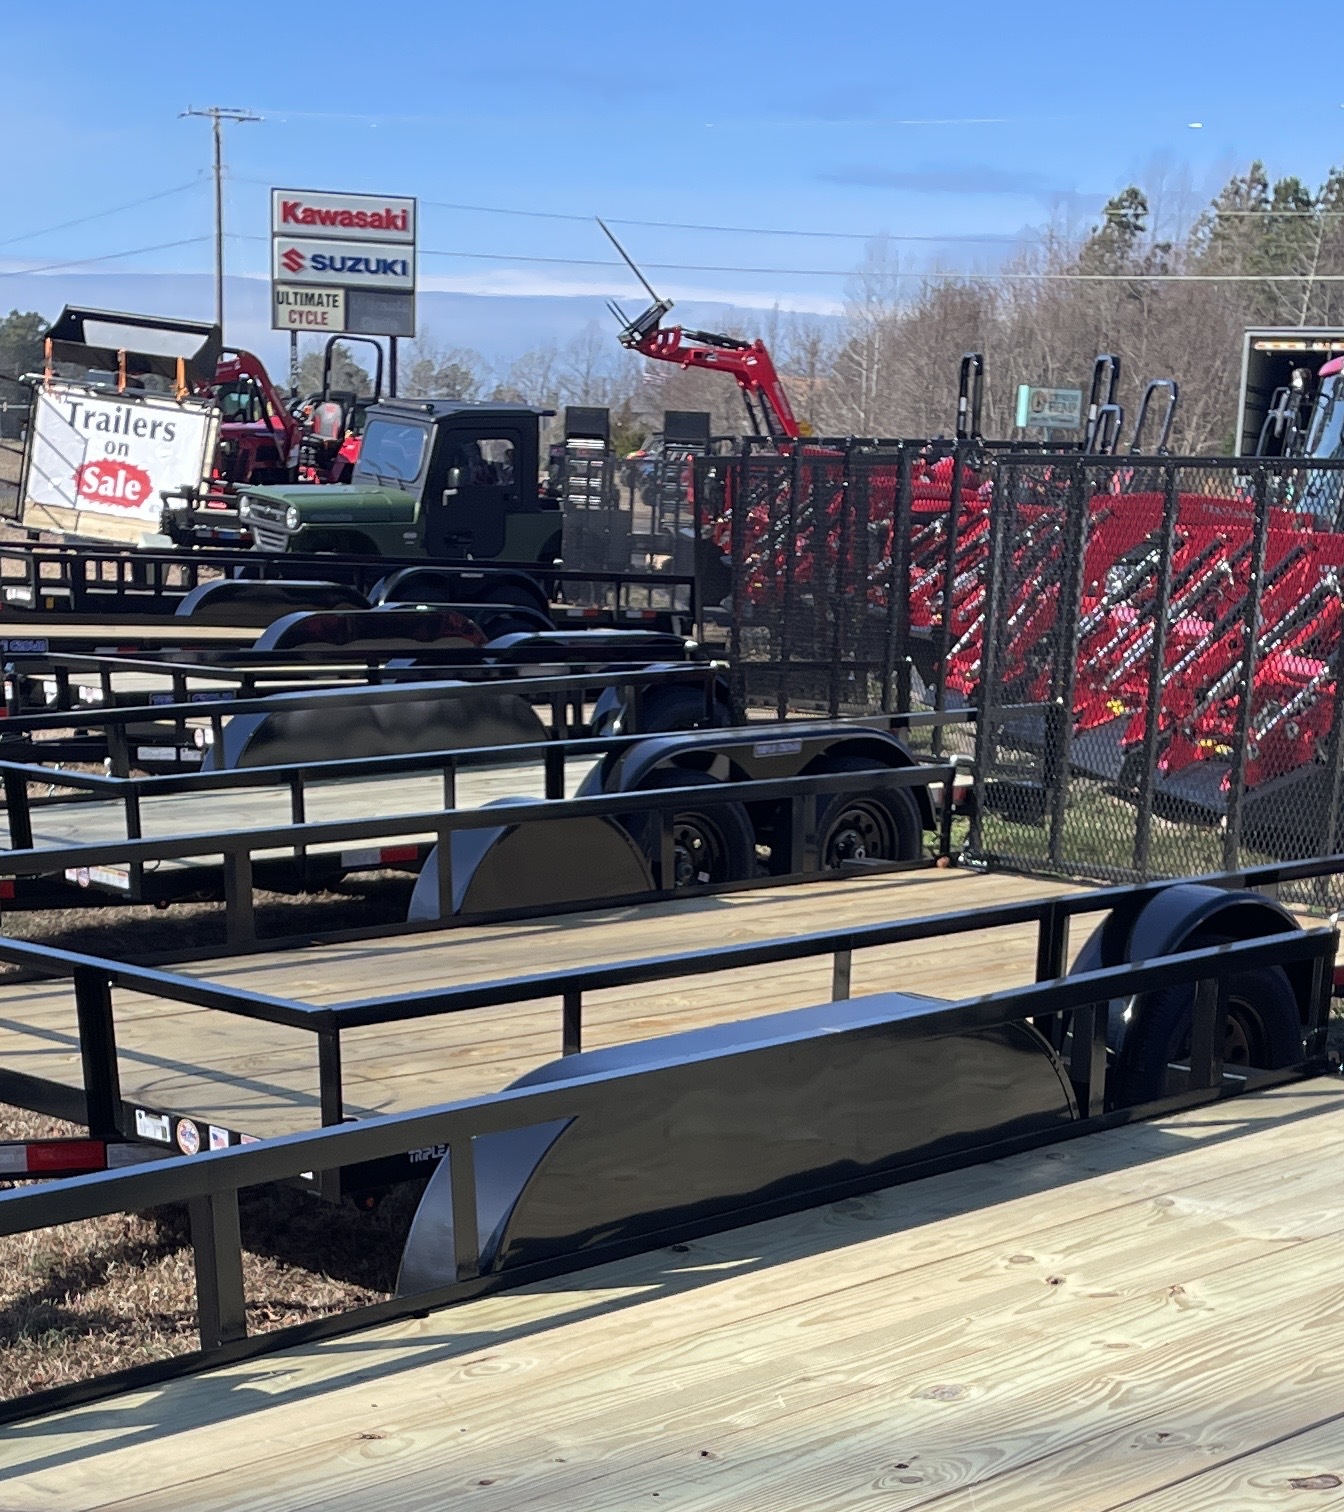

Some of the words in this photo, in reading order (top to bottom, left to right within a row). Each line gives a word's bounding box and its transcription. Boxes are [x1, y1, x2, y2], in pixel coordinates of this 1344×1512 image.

[282, 201, 408, 231] Kawasaki
[310, 254, 409, 276] SUZUKI
[276, 290, 340, 308] ULTIMATE
[288, 309, 329, 326] CYCLE
[65, 399, 177, 442] Trailers
[104, 439, 130, 457] on
[81, 466, 142, 500] Sale
